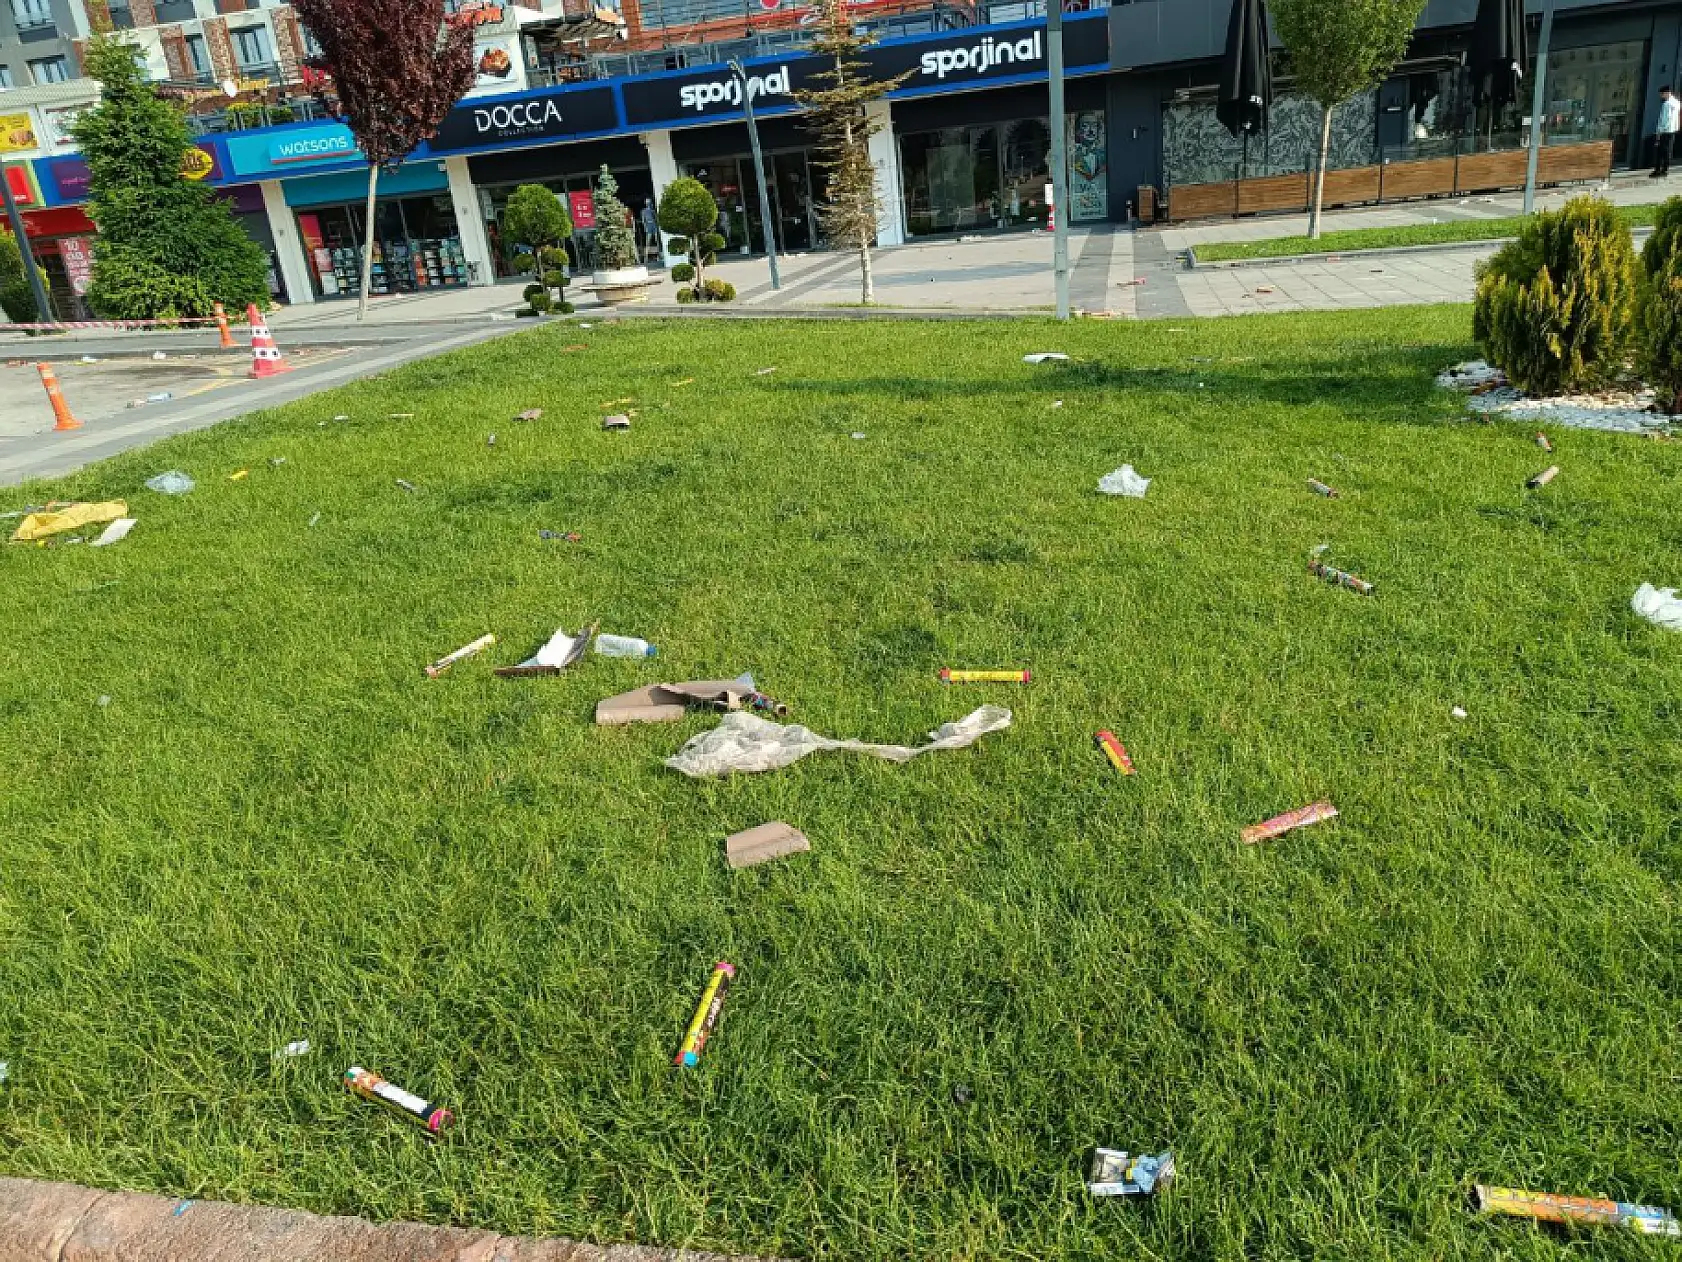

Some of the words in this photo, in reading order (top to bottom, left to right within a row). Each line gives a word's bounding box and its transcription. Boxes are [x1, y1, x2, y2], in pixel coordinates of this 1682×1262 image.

[920, 30, 1042, 79] sporjinal
[680, 65, 790, 111] sporjnal
[474, 99, 563, 132] DOCCA
[278, 137, 349, 156] watsons
